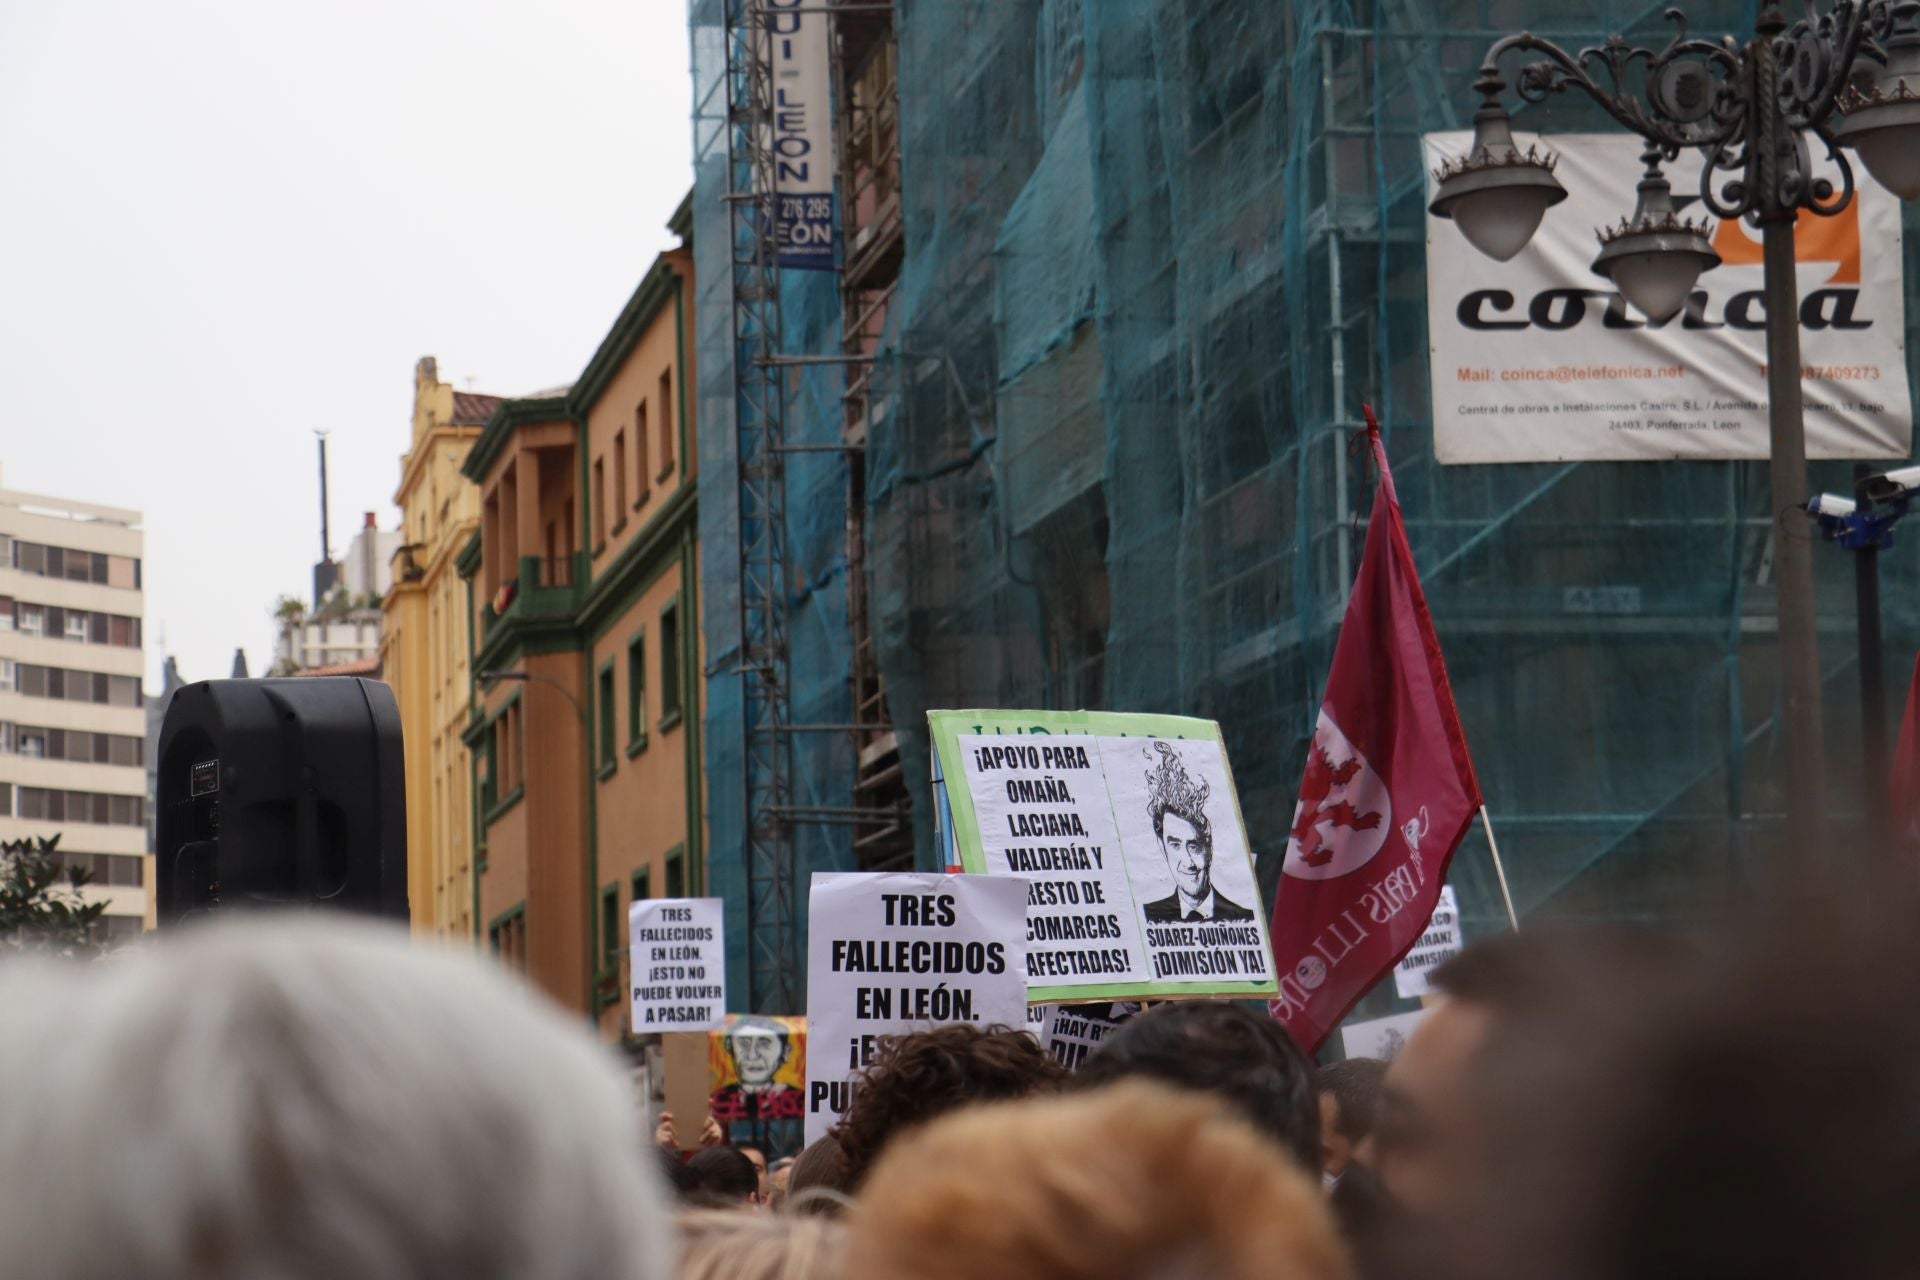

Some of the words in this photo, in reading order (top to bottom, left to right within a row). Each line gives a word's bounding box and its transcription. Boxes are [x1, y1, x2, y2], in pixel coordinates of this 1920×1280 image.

[807, 198, 831, 219] 295
[777, 220, 832, 244] EÓN
[1457, 367, 1495, 382] Mail:
[1501, 365, 1684, 384] coinca@telefonica.net
[1458, 404, 1498, 416] Central
[1501, 403, 1515, 414] de
[1518, 403, 1549, 414] obras
[1563, 401, 1636, 413] Instalaciones
[1713, 401, 1758, 411] Avenida
[1859, 402, 1884, 414] bajo
[974, 746, 1040, 773] ¡APOYO
[1042, 745, 1090, 769] PARA
[1006, 775, 1075, 804] OMAÑA,
[1007, 813, 1089, 839] LACIANA,
[1005, 843, 1092, 872] VALDERÍA
[1090, 846, 1103, 870] Y
[1081, 881, 1105, 904] DE
[660, 908, 692, 922] TRES
[881, 894, 955, 927] TRES
[640, 927, 713, 942] FALLECIDOS
[1026, 914, 1121, 941] COMARCAS
[651, 947, 666, 961] EN
[670, 944, 702, 960] LEÓN.
[832, 940, 1005, 975] FALLECIDOS
[1026, 949, 1131, 976] AFECTADAS!
[1154, 948, 1238, 978] ¡DIMISIÓN
[1239, 950, 1266, 975] YA!
[649, 966, 685, 981] ¡ESTO
[688, 966, 705, 979] NO
[633, 986, 672, 1000] PUEDE
[675, 985, 722, 999] VOLVER
[857, 987, 891, 1019] EN
[901, 982, 980, 1020] LEÓN.
[645, 1008, 655, 1023] A
[658, 1006, 711, 1022] PASAR!
[1053, 1018, 1089, 1038] ¡HAY
